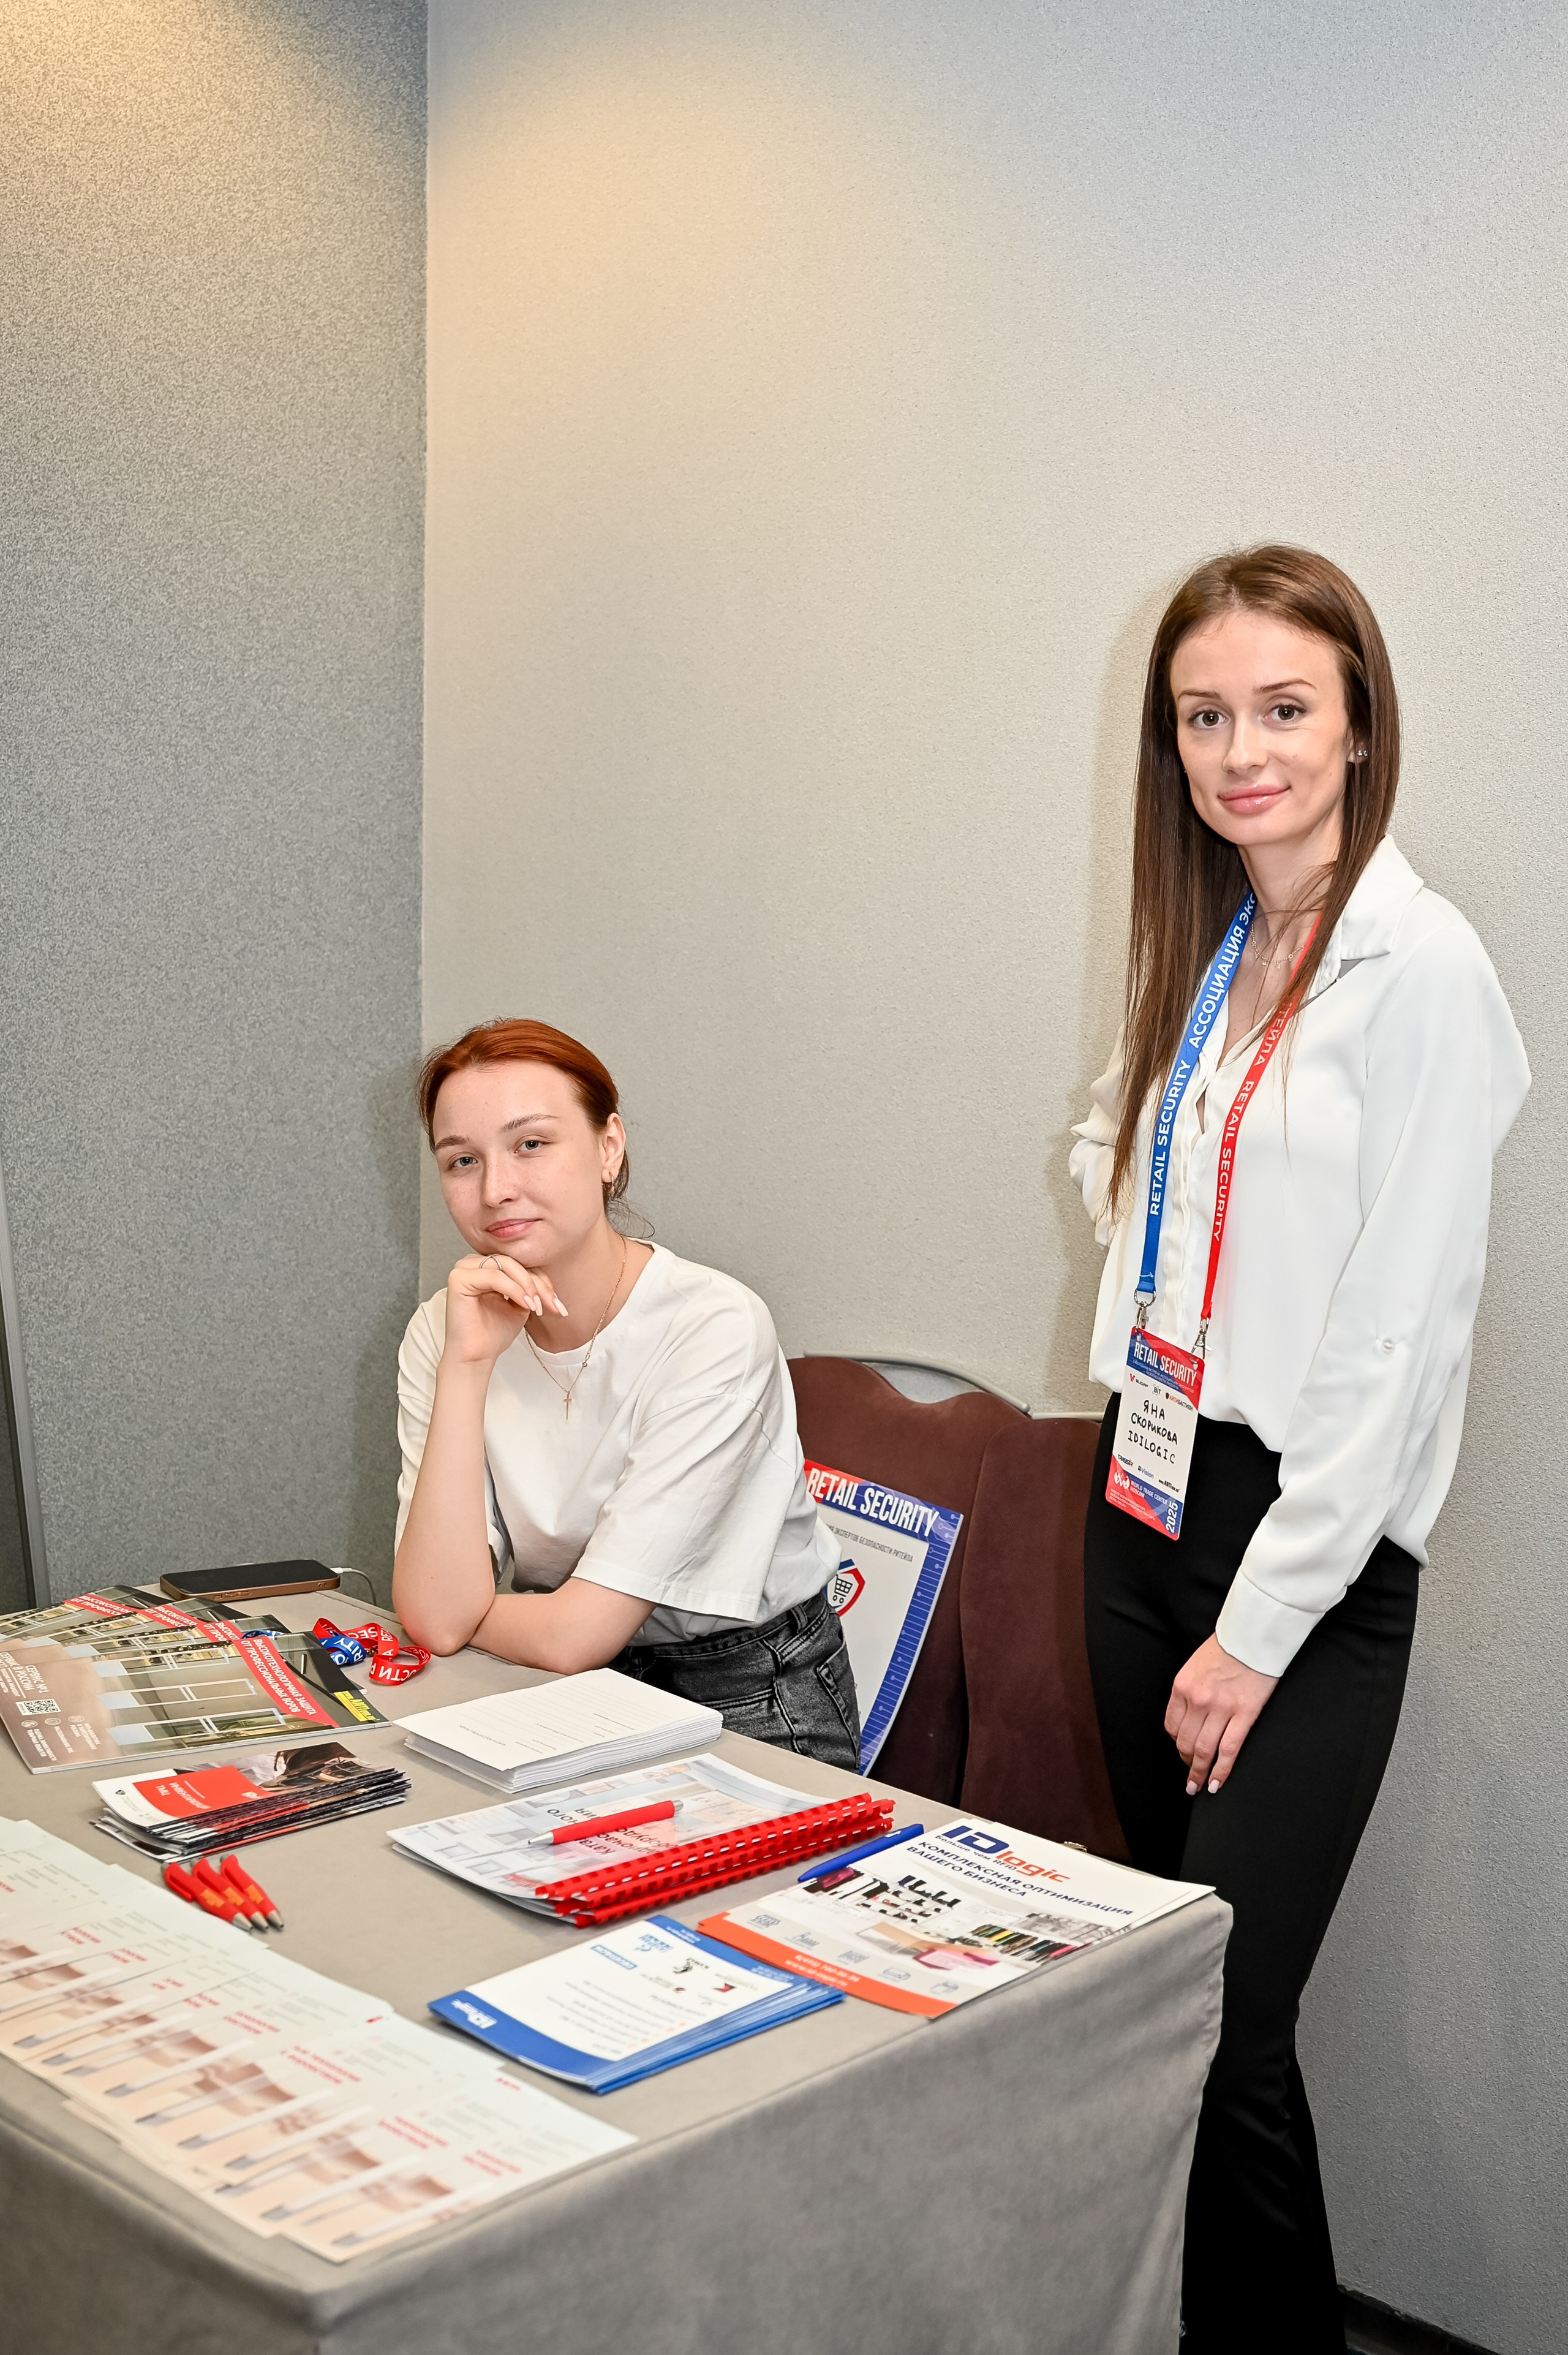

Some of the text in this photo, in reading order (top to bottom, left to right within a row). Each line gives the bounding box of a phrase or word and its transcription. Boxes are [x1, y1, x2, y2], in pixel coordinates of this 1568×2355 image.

[1189, 927, 1245, 1048] АССОЦИАЦИЯ
[1150, 1059, 1191, 1215] RETAIL SECURITY
[1213, 1080, 1254, 1242] RETAIL SECURITY
[1134, 1342, 1158, 1368] RETAIL
[1160, 1355, 1197, 1386] SECURITY
[1131, 1412, 1178, 1445] СКОРИКОВА
[1144, 1399, 1165, 1420] ЯНА
[1128, 1430, 1175, 1464] IDILOGIC
[807, 1468, 940, 1537] RETAIL SECURITY
[1131, 1480, 1167, 1505] WORLD TRADE CENTER
[1166, 1502, 1178, 1533] 2025
[241, 1640, 301, 1713] ОТ ПРОФЕССИОНАЛЬНЫХ ВОРОВ
[253, 1639, 317, 1715] ВЫСОКОТЕХНОЛОГИЧНАЯ ЗАЩИТА
[907, 1847, 1028, 1897] ВАШЕГО БИЗНЕСА
[935, 1835, 1017, 1870] Больше чем RFID
[918, 1841, 1134, 1916] КОМПЛЕКСНАЯ ОПТИМИЗАЦИЯ
